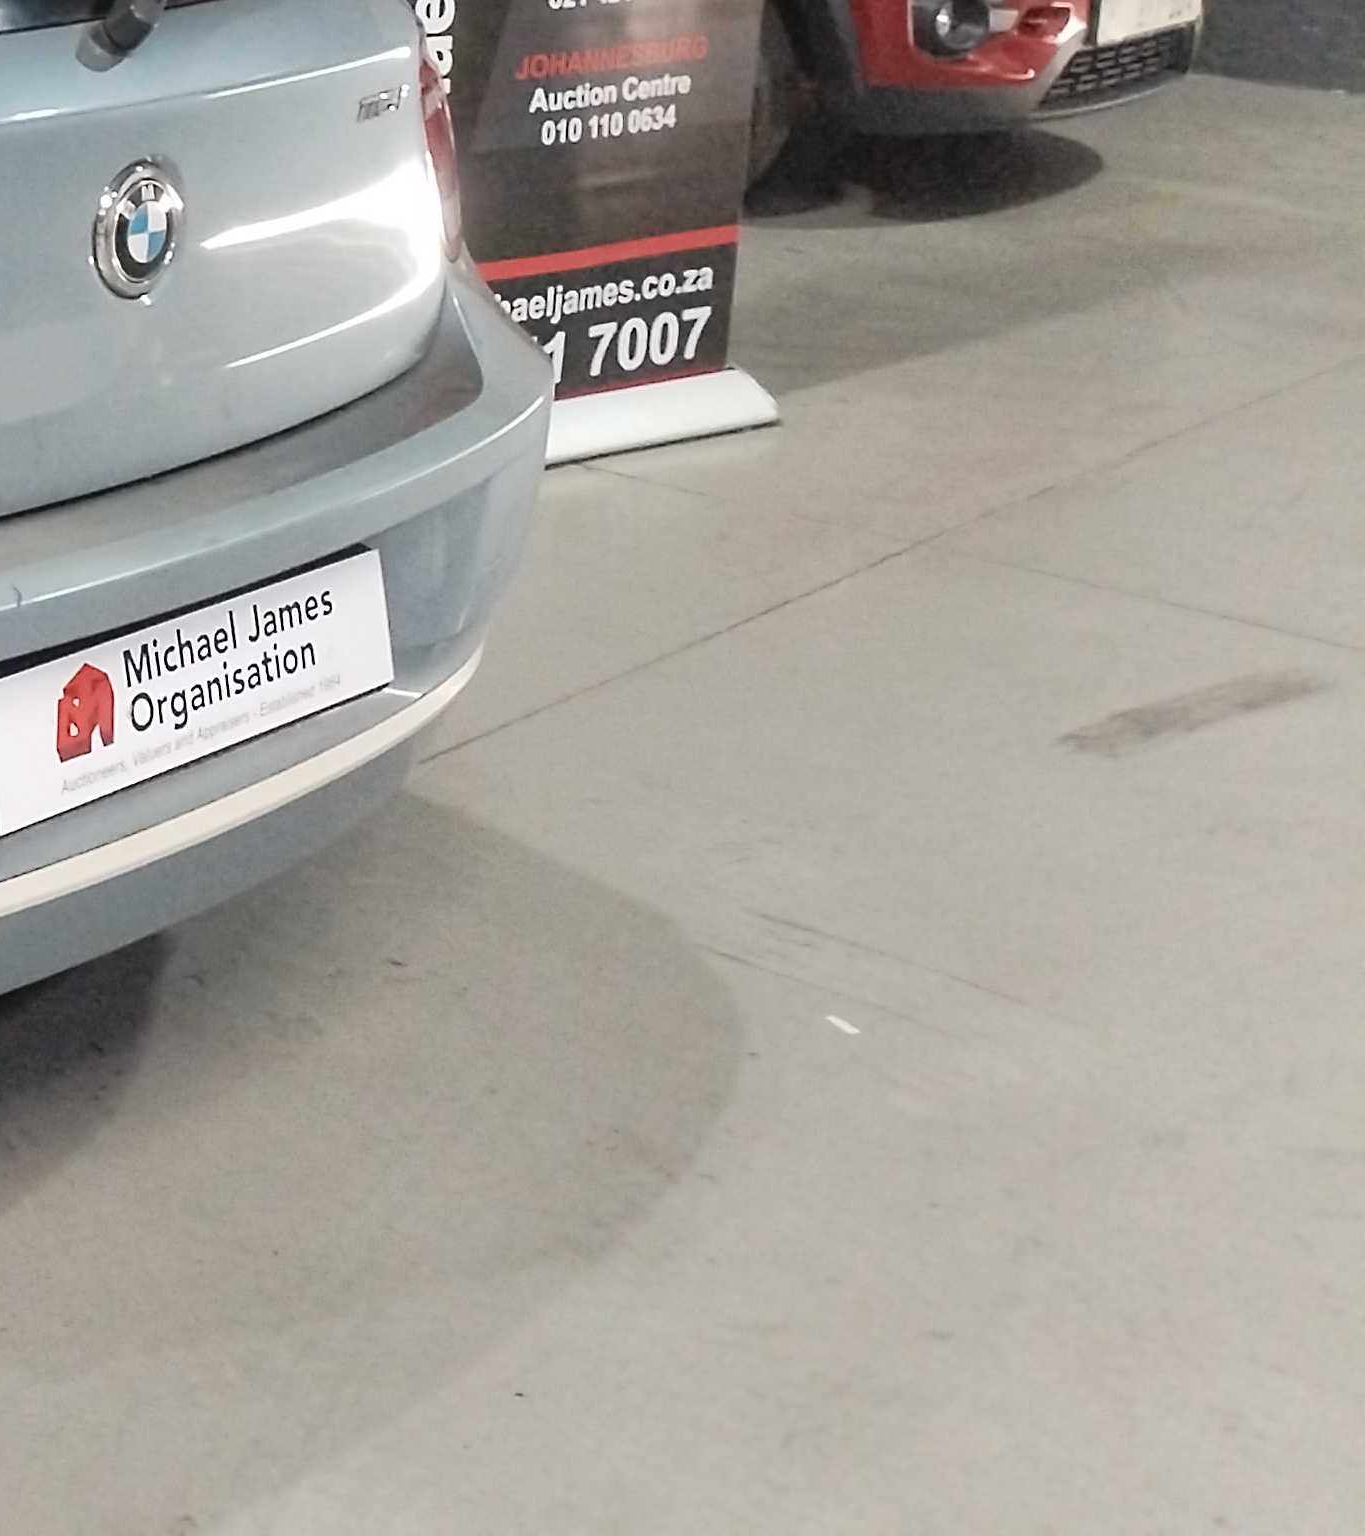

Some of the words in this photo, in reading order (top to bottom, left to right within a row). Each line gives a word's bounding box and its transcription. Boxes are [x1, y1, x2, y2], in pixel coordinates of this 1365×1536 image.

[528, 81, 618, 114] Auction
[622, 72, 693, 103] Centre
[540, 117, 583, 147] 010
[588, 110, 624, 140] 110
[627, 103, 677, 135] 0634
[587, 305, 713, 377] 7007
[122, 610, 237, 688] Michael
[248, 588, 334, 643] James
[130, 640, 317, 730] Organisation
